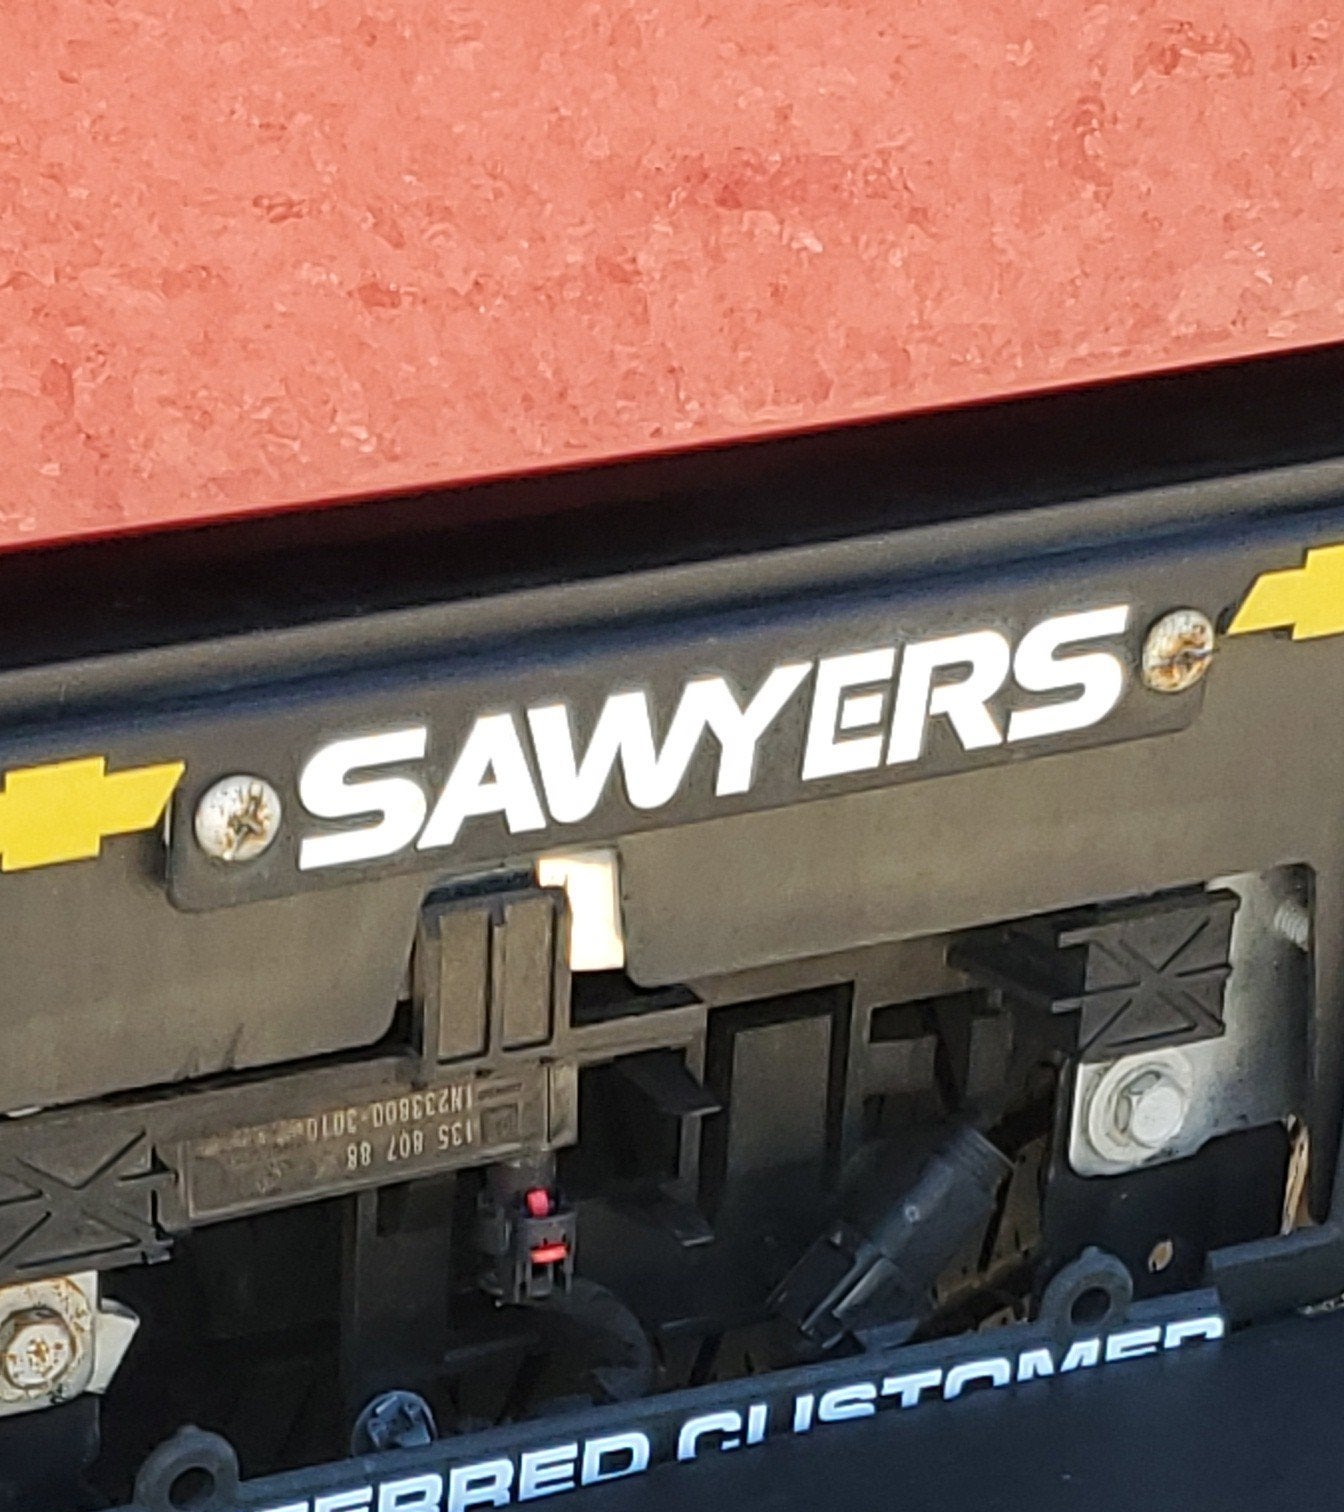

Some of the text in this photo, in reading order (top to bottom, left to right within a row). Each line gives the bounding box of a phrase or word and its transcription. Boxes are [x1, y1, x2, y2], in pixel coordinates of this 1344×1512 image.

[298, 605, 1130, 870] SAWYERS
[387, 1129, 424, 1162] 807
[438, 1118, 473, 1150] 135
